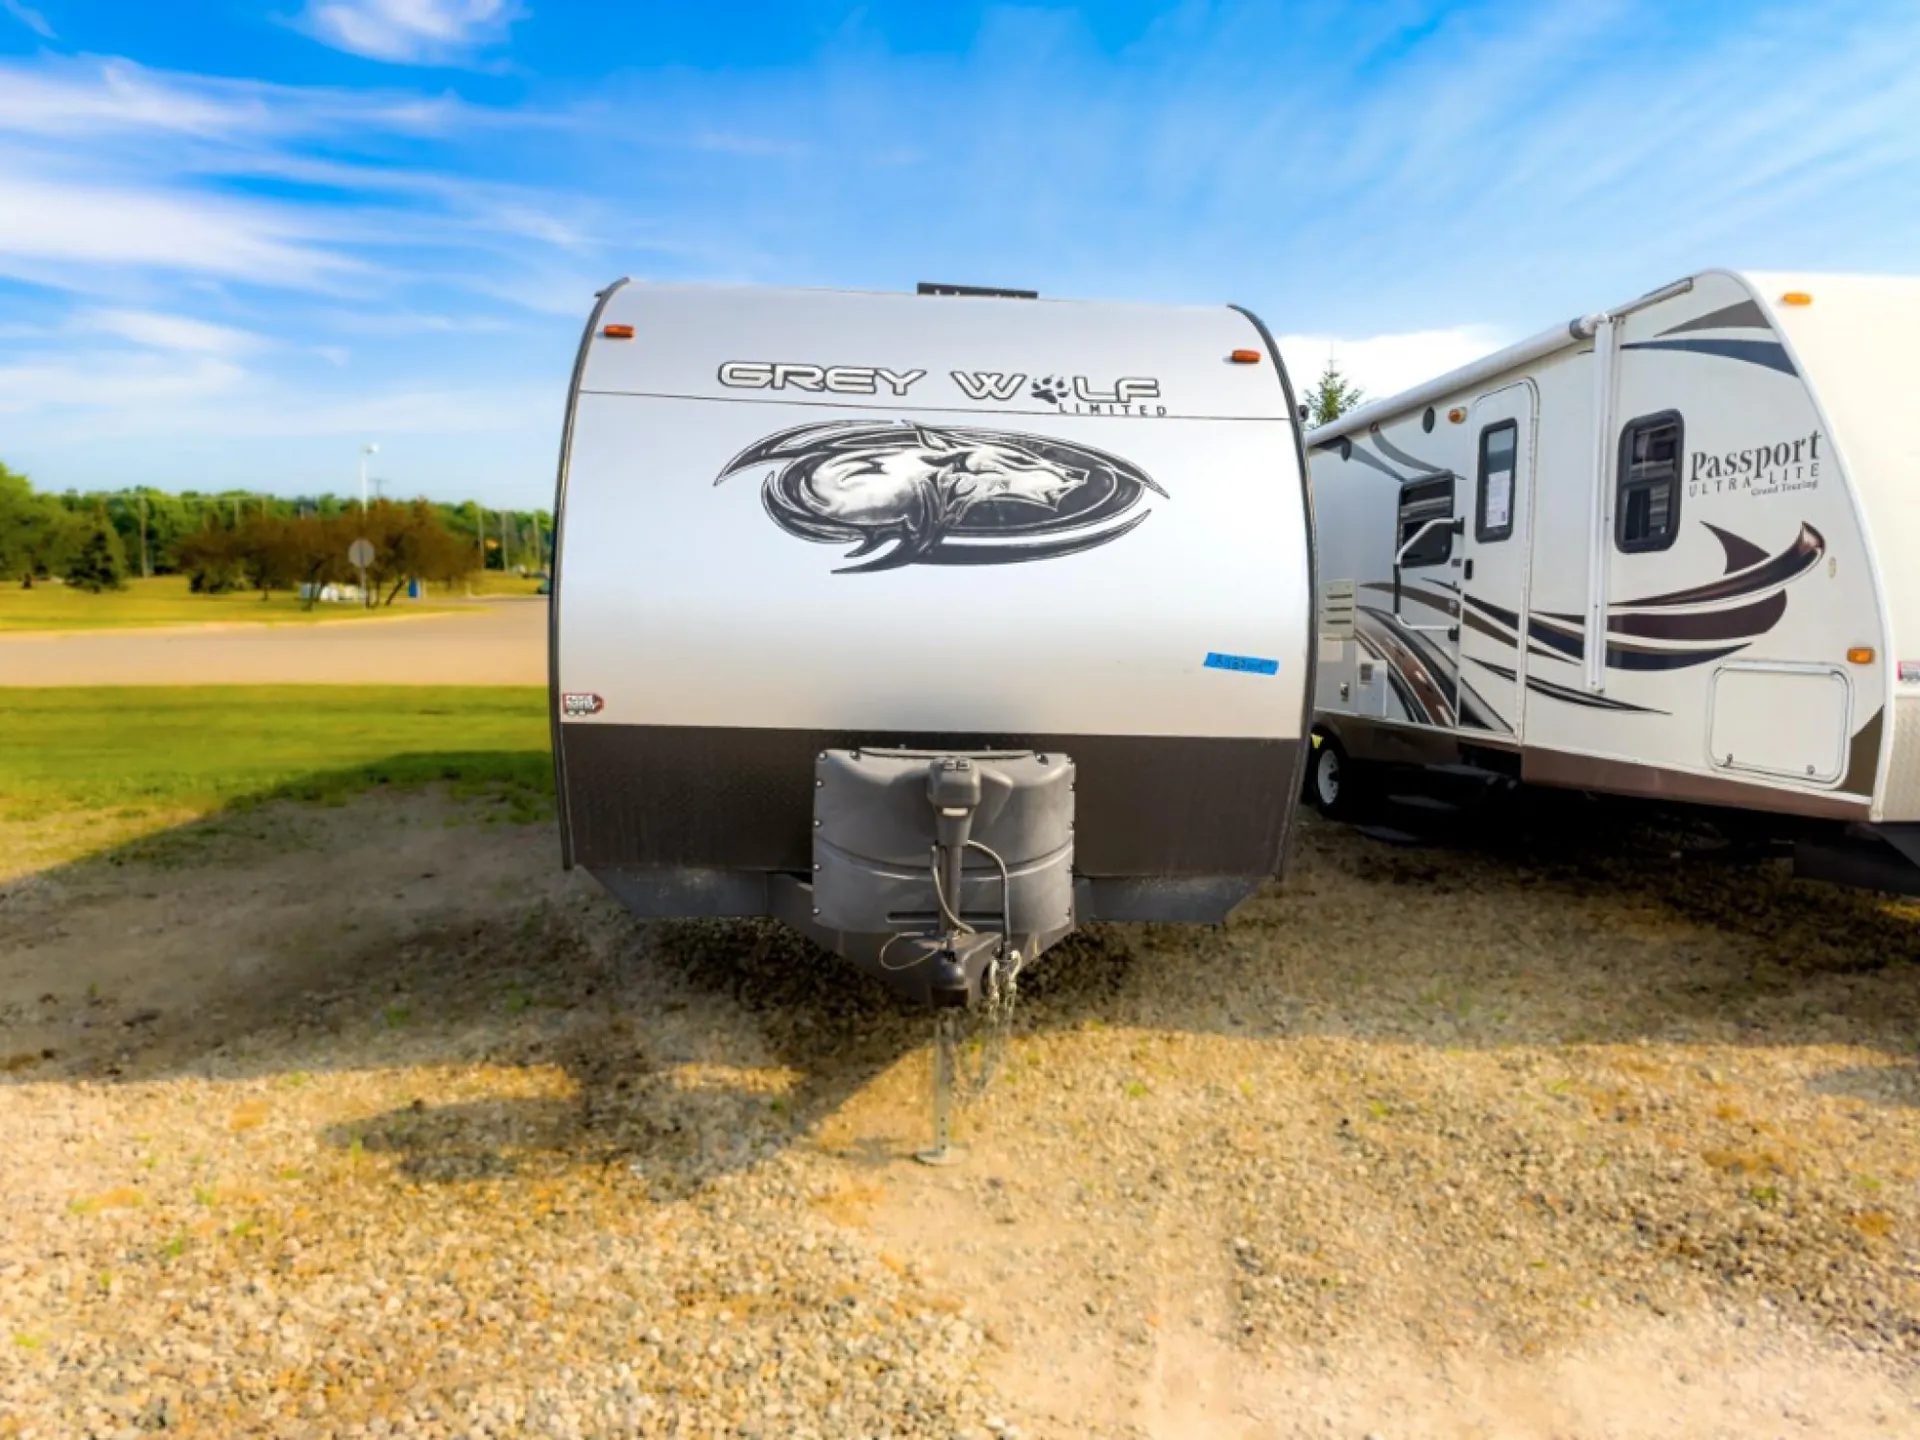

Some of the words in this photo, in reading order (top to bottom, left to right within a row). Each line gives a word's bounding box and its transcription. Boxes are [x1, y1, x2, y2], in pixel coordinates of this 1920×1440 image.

[717, 360, 927, 396] GREY
[1059, 402, 1167, 417] LIMITED
[1689, 429, 1822, 483] Passport
[1689, 477, 1751, 498] ULTRA
[1769, 462, 1820, 485] LITE
